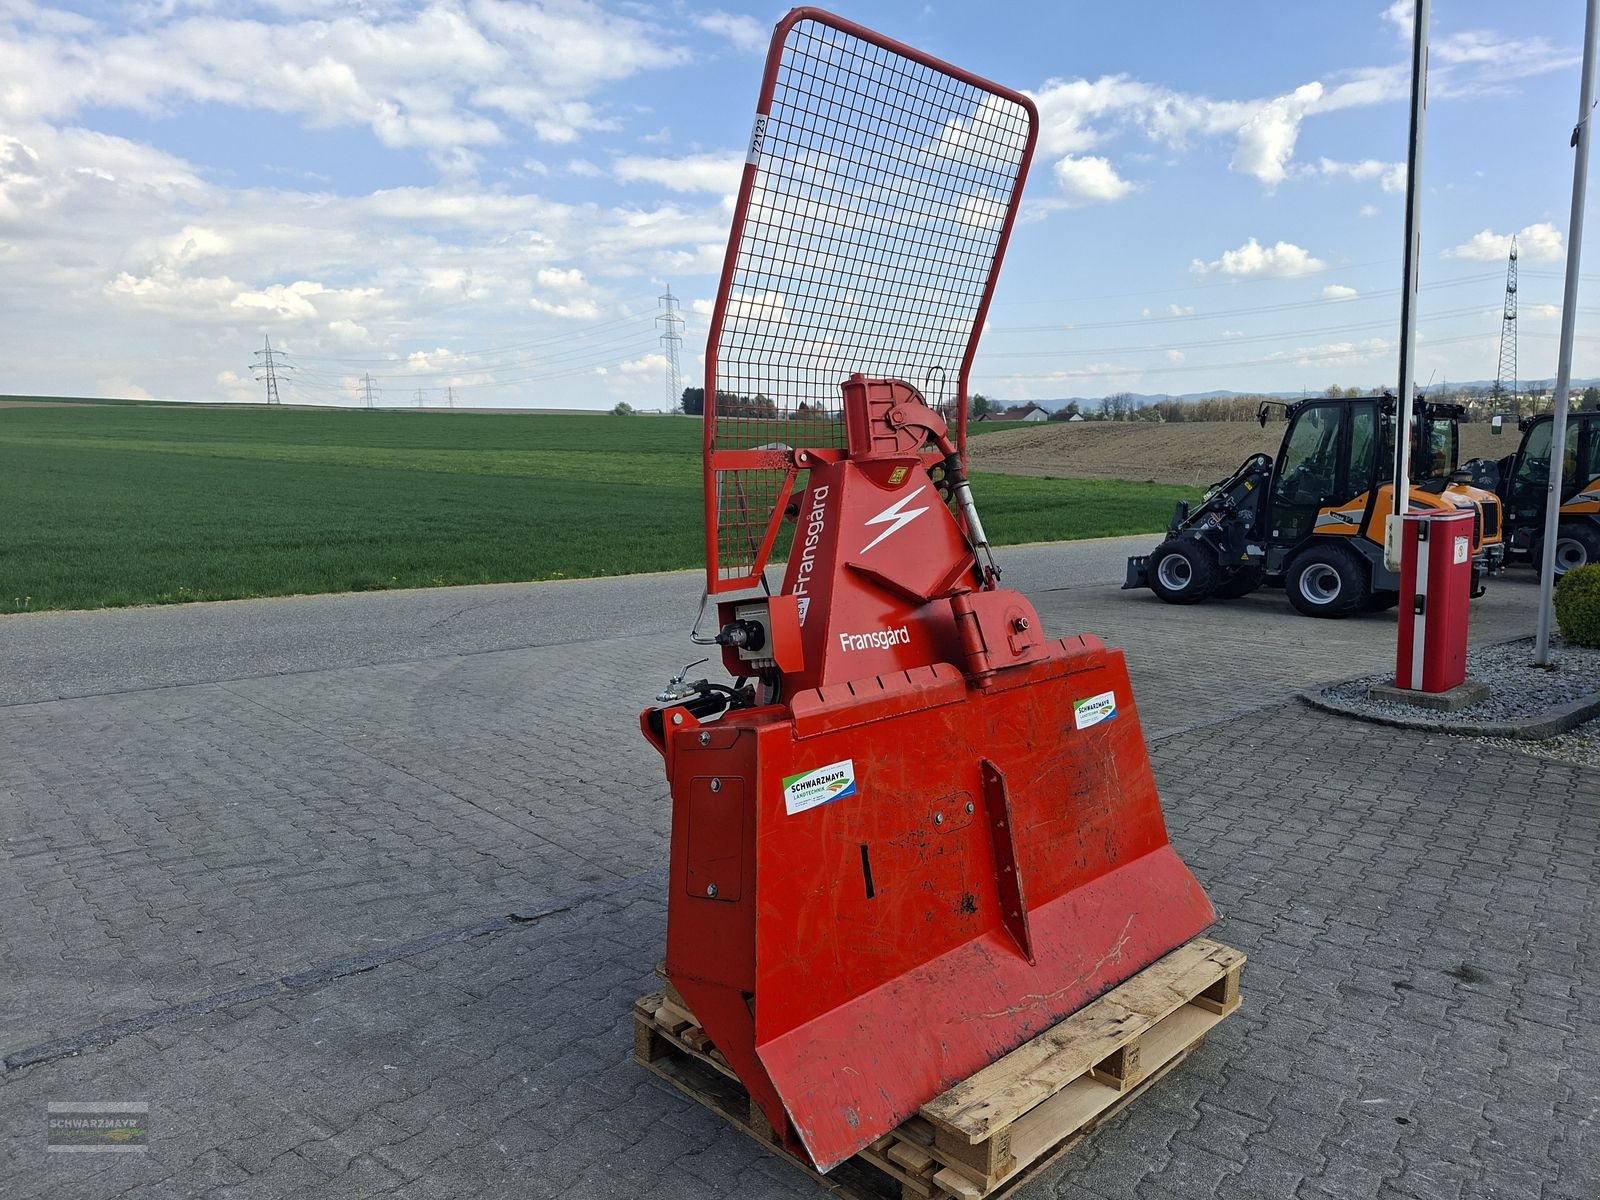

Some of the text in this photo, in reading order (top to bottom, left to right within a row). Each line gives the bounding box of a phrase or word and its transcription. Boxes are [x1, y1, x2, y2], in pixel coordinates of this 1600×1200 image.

[752, 119, 766, 153] 72123
[793, 485, 829, 596] Fransgård
[840, 626, 910, 651] Fransgård
[1078, 699, 1110, 714] SCHWARZMAYR
[791, 770, 845, 793] SCHWARZMAYR
[793, 787, 825, 800] LANDTECHNIK
